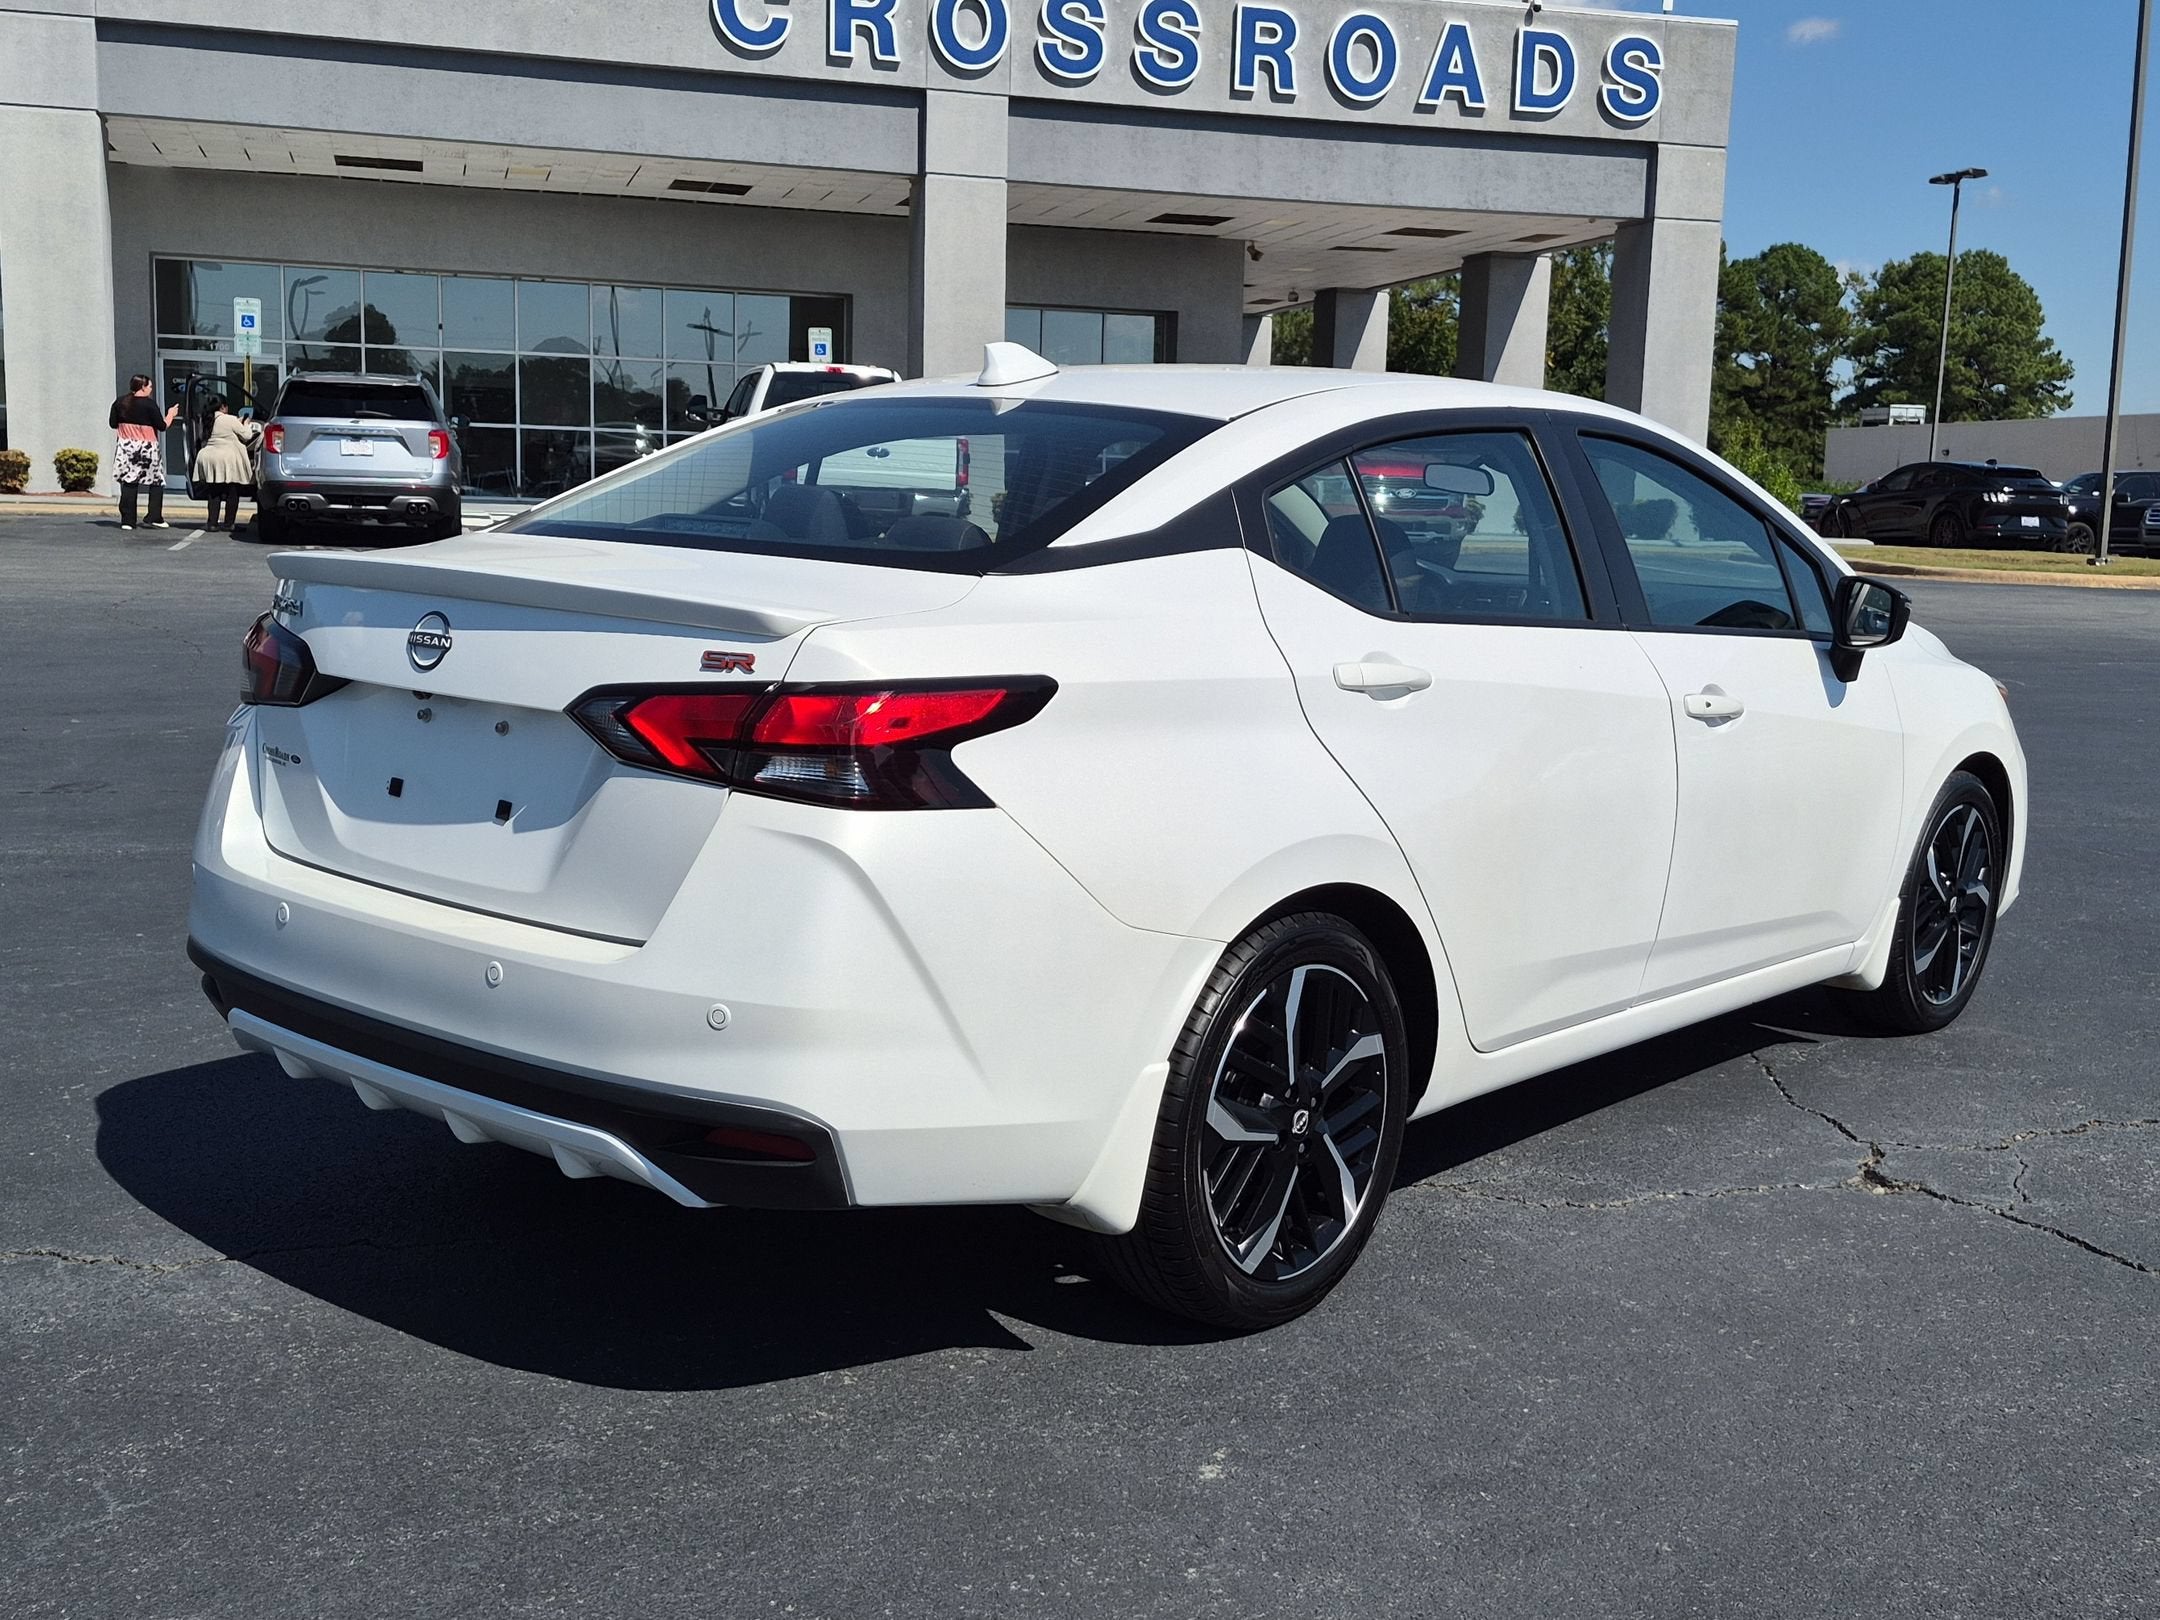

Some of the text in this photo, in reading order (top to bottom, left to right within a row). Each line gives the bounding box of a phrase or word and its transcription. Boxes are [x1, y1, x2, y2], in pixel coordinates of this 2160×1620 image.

[711, 0, 1665, 121] CROSSROADS
[409, 634, 451, 648] NISSAN
[702, 651, 756, 672] SR
